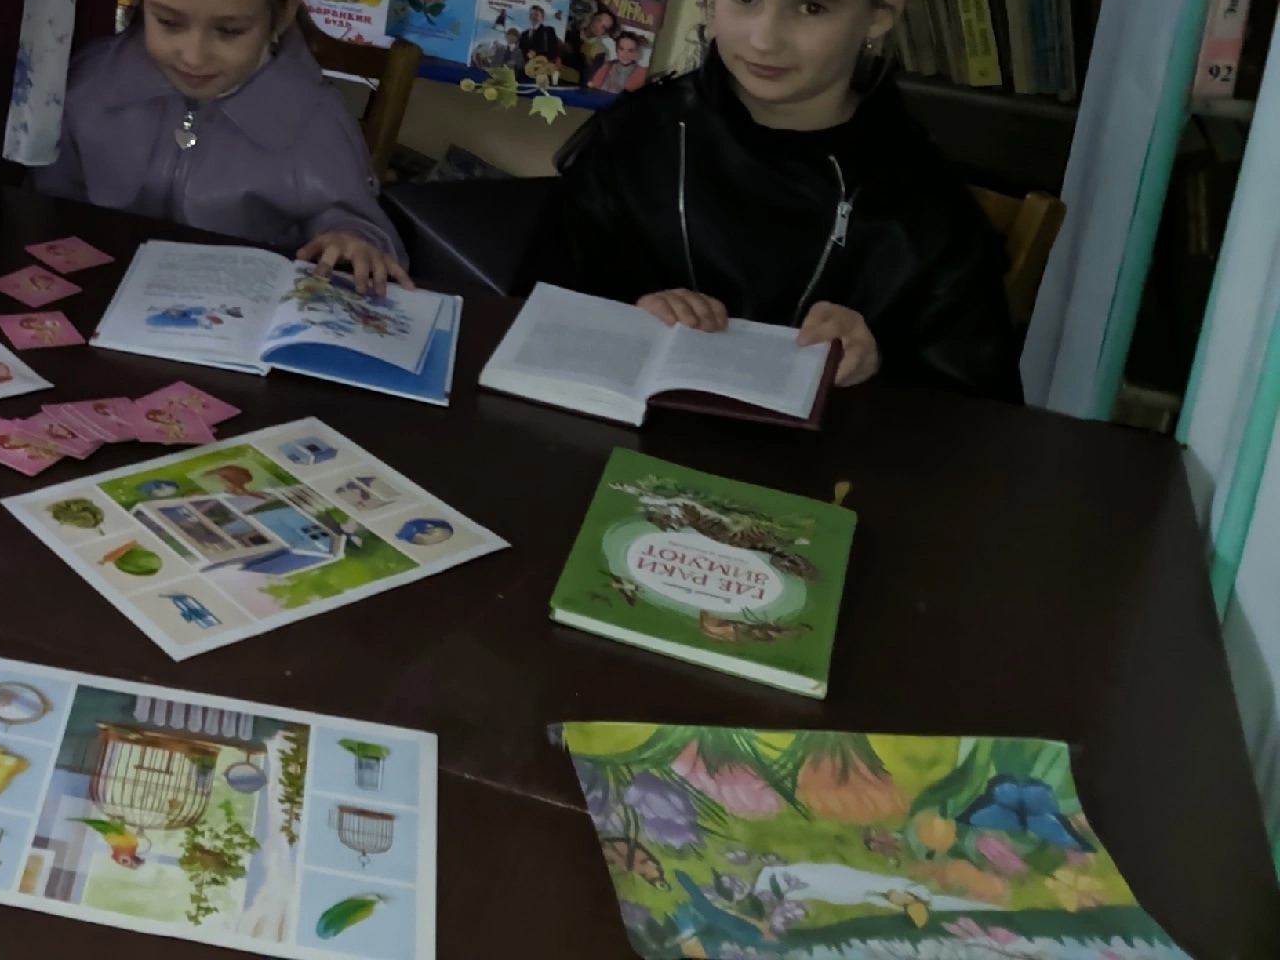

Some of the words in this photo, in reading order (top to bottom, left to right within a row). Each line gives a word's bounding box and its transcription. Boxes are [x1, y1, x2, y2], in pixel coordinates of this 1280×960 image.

[1208, 64, 1233, 82] 92
[637, 557, 708, 586] РАКИ
[642, 544, 769, 586] ЗИМУЮТ
[719, 578, 766, 600] ГДЕ
